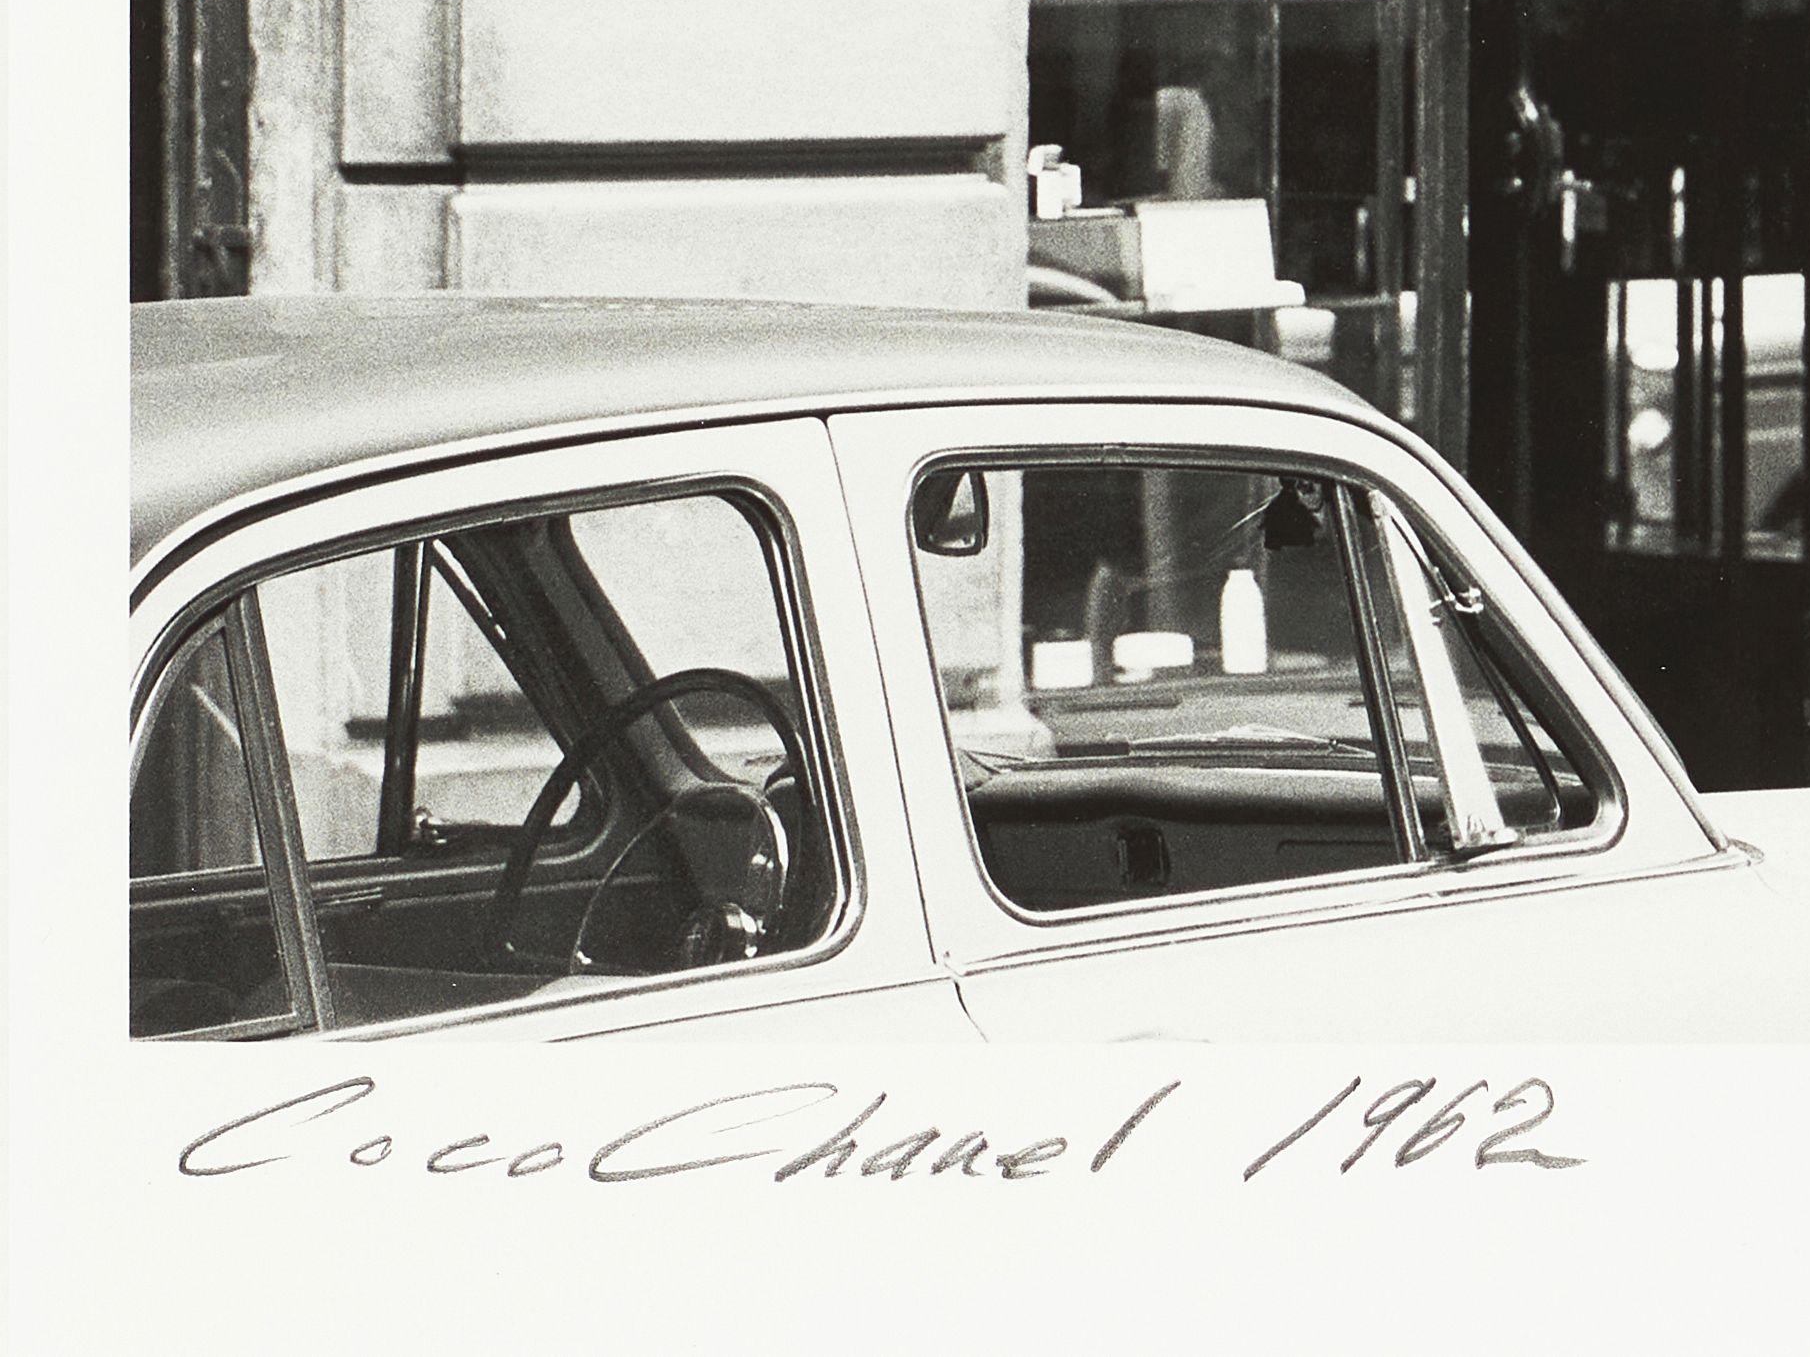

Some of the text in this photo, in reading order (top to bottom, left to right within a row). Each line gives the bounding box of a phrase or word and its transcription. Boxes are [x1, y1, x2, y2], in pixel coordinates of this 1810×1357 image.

[178, 1075, 1588, 1184] Coco Chanel 1962
